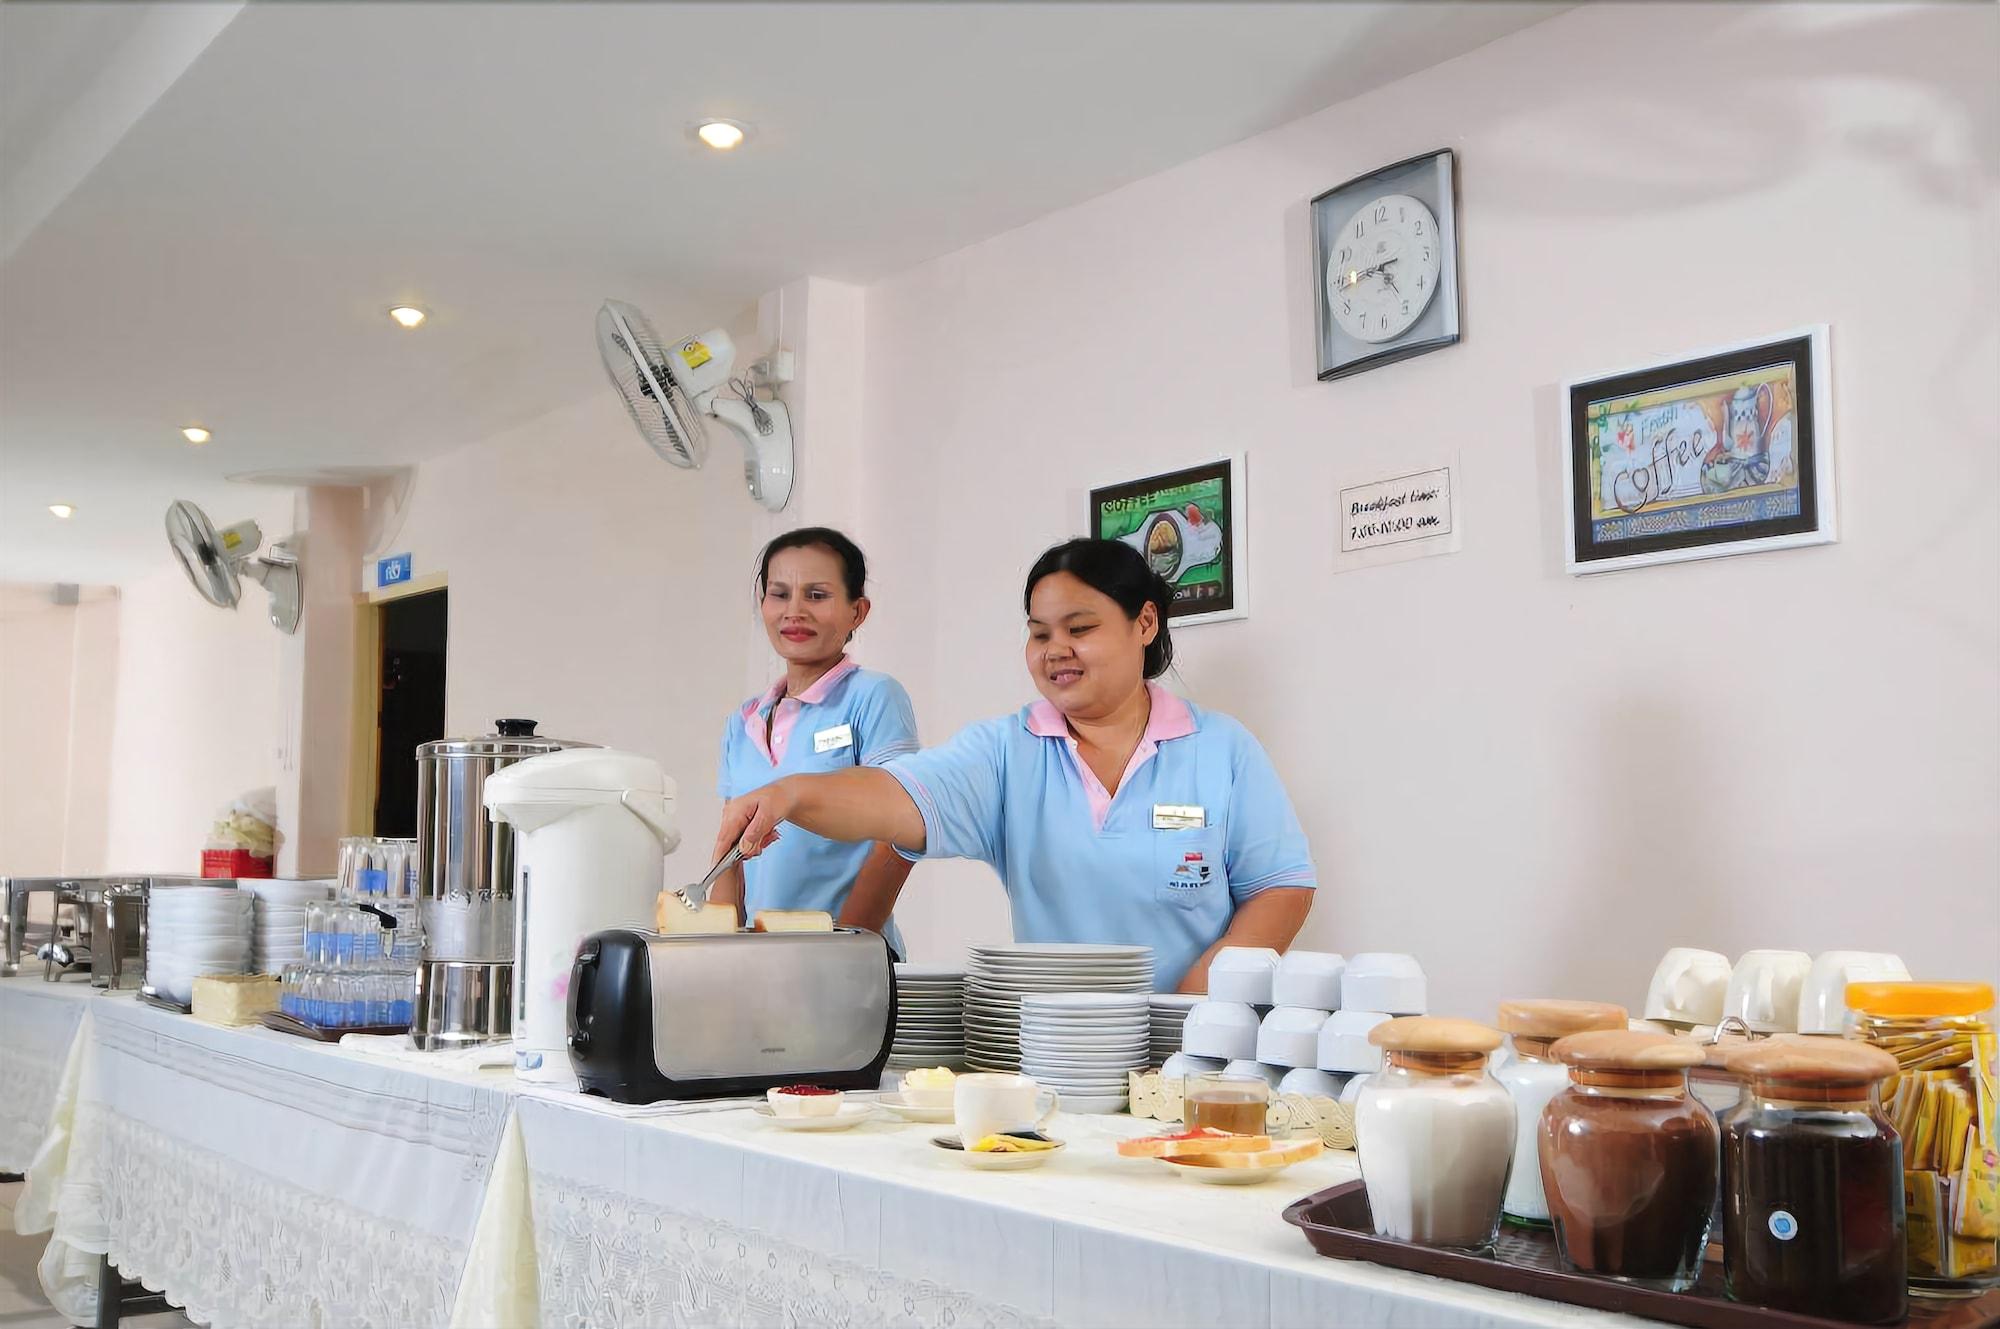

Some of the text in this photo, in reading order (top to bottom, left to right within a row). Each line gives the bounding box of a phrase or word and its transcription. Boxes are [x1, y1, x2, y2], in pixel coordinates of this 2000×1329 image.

[1374, 206, 1389, 225] 12
[1414, 220, 1424, 236] 2
[1358, 312, 1367, 330] 7
